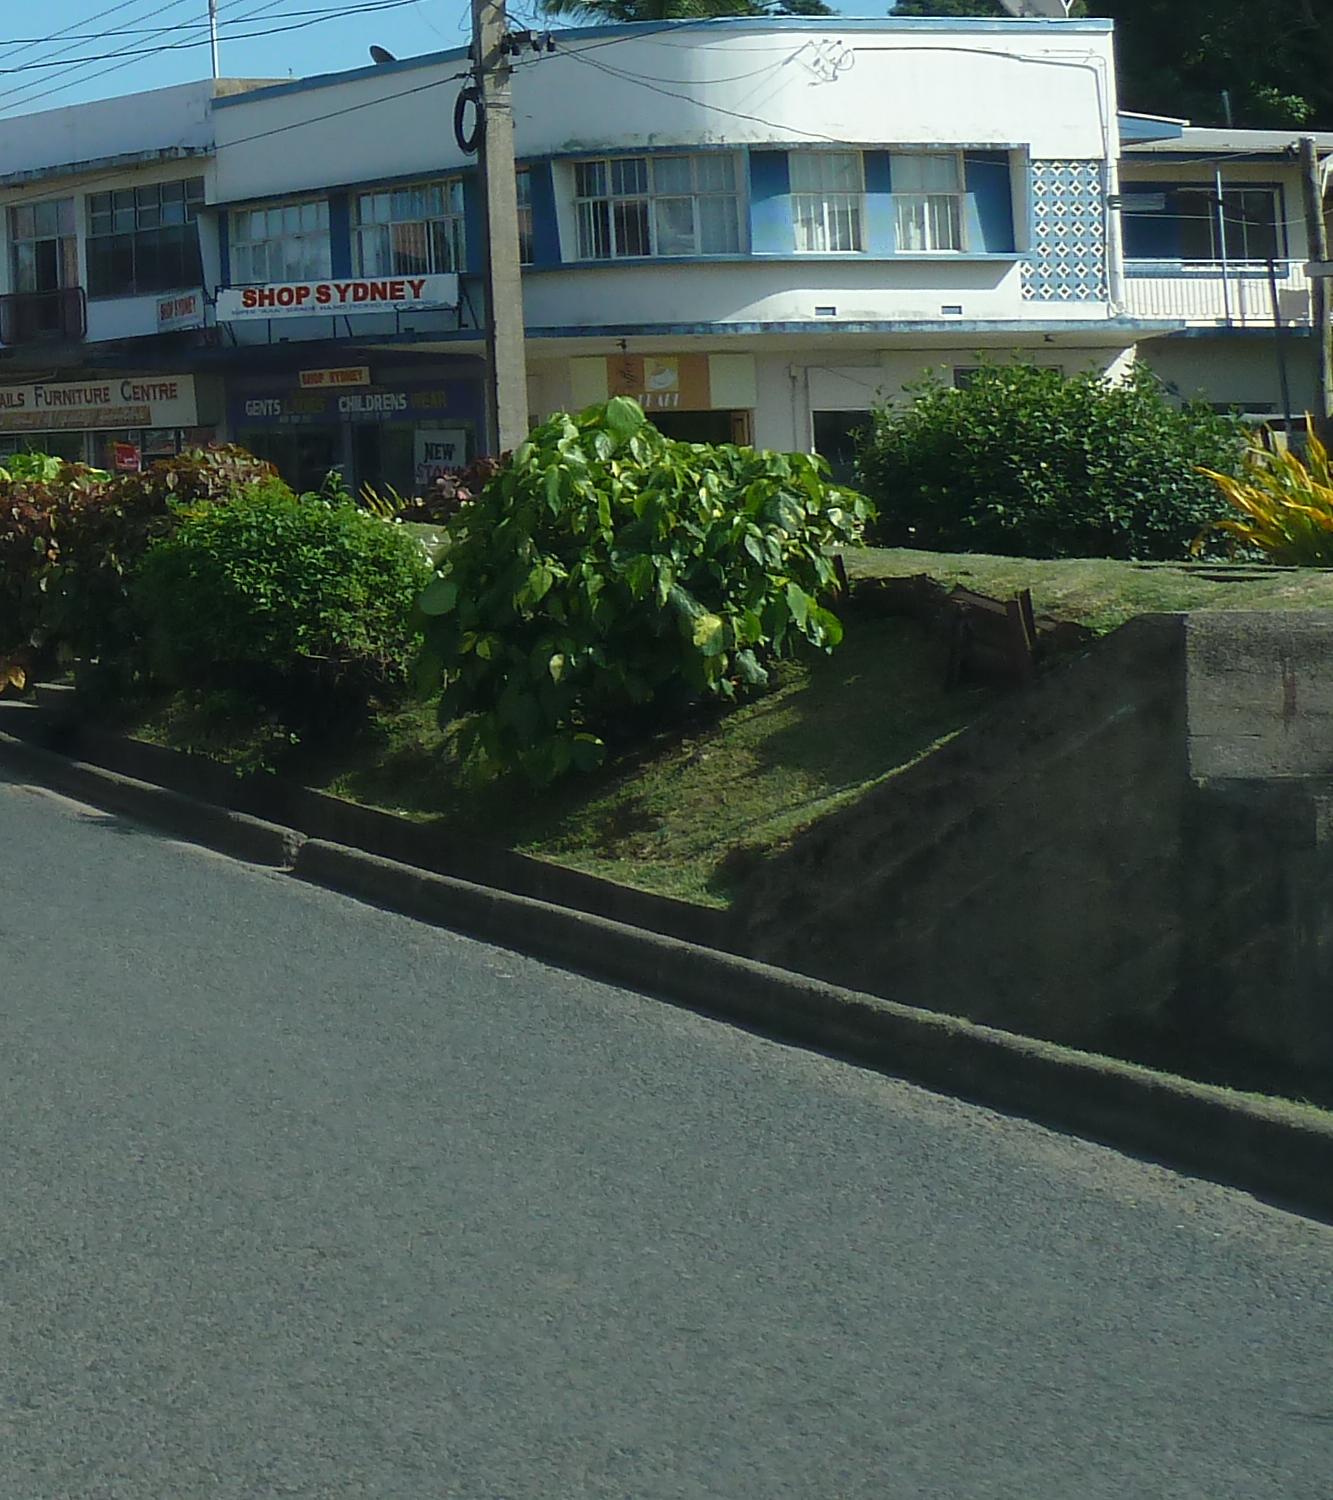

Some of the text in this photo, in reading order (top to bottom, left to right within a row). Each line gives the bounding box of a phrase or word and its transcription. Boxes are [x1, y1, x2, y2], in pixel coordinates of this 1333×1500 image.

[242, 279, 427, 308] SHOP SYDNEY
[34, 386, 111, 407] FURNITURE
[121, 380, 177, 401] CENTRE
[245, 399, 281, 417] GENTS
[338, 393, 408, 413] CHILDRENS
[424, 442, 455, 463] NEW
